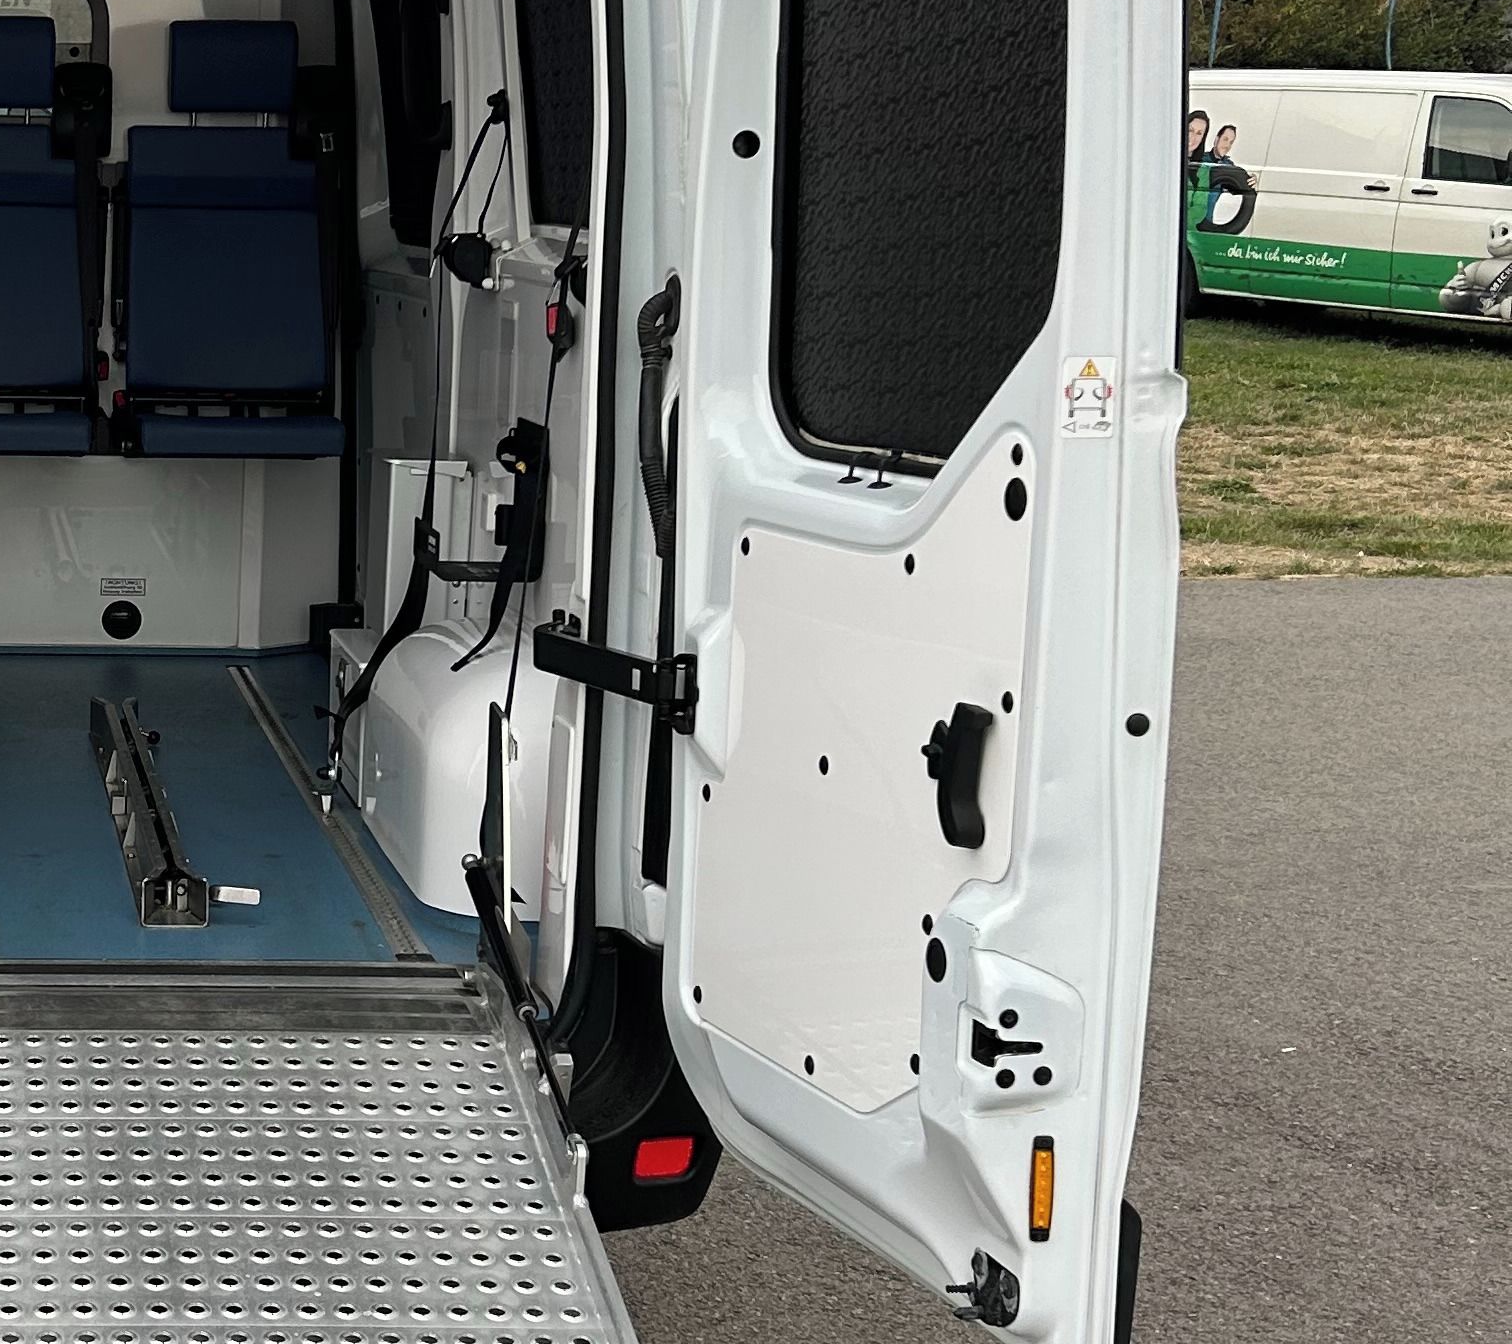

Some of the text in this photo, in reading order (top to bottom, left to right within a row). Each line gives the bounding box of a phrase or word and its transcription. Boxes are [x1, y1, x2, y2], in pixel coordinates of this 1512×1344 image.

[1246, 244, 1262, 260] bin
[1264, 246, 1280, 262] ich
[1283, 250, 1304, 265] mir
